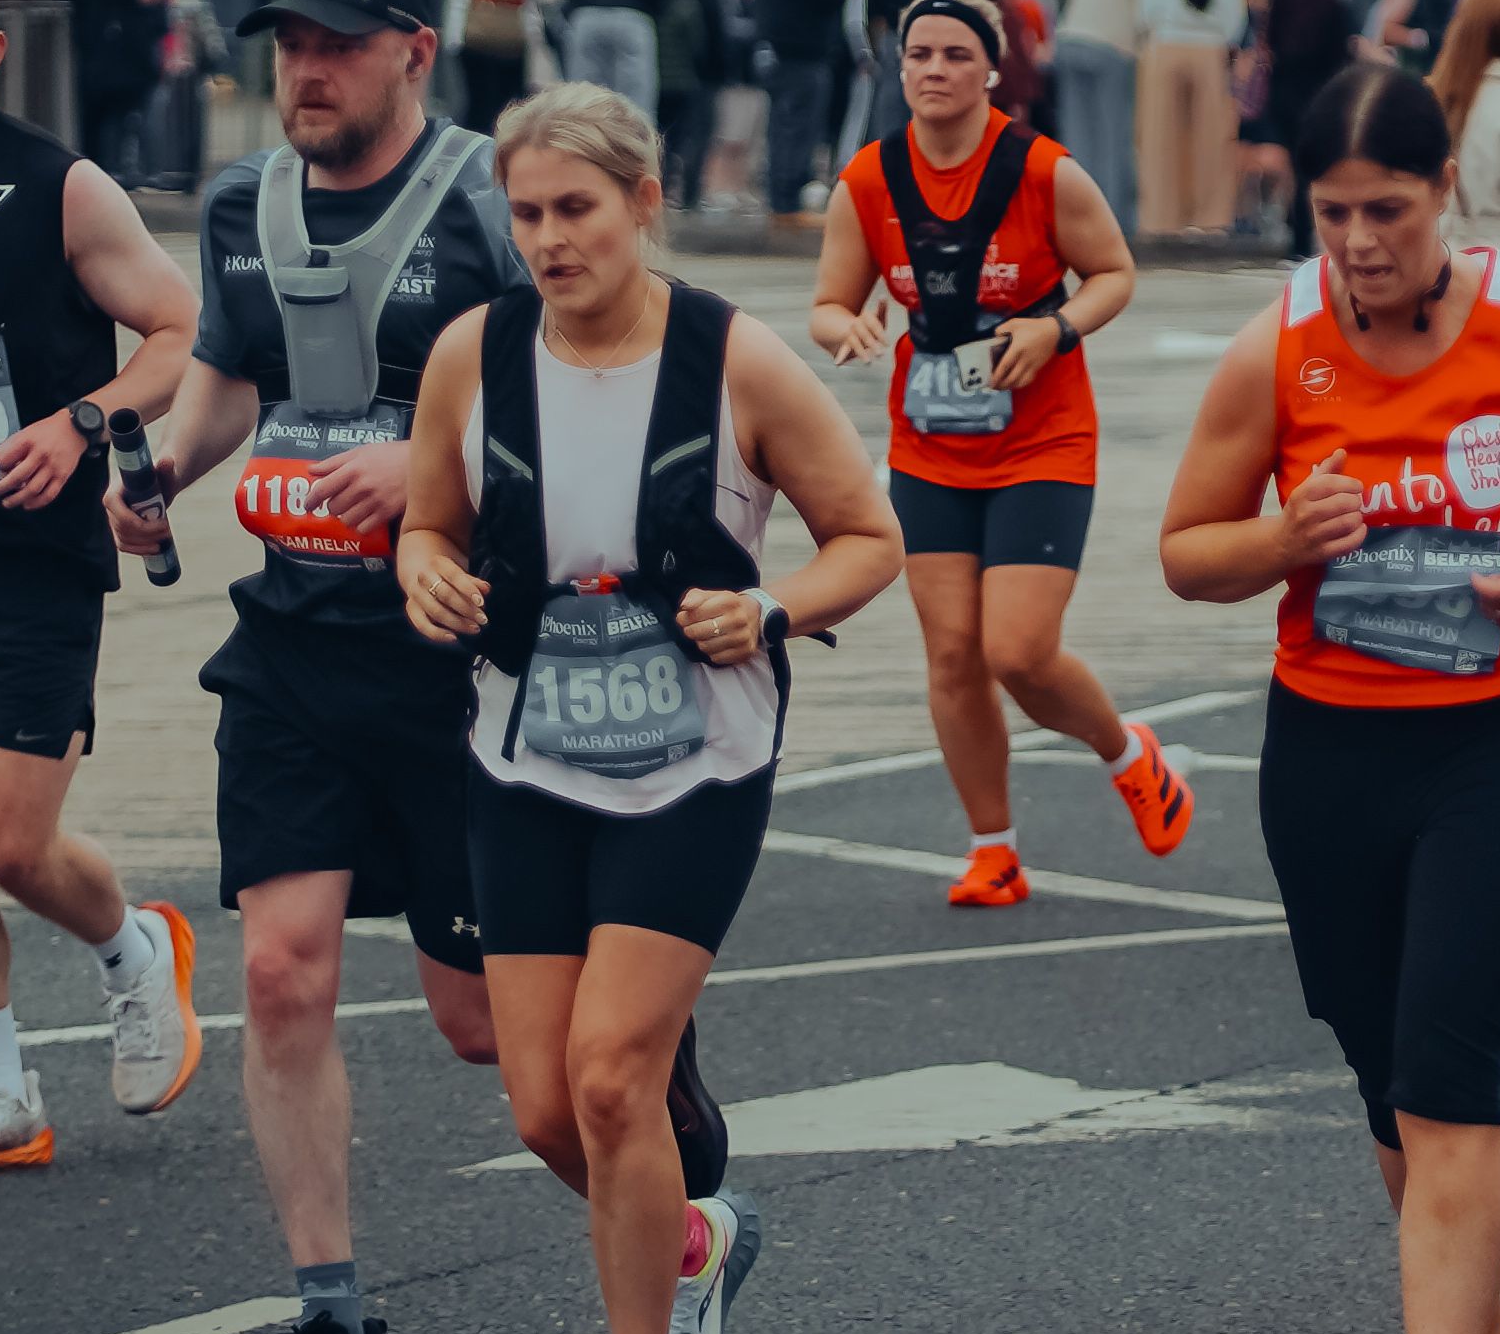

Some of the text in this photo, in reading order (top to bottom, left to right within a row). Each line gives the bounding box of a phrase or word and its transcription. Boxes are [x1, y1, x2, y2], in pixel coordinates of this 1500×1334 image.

[232, 255, 265, 271] KUK
[328, 427, 397, 444] BELFAST
[1399, 455, 1446, 514] to
[312, 536, 361, 553] RELAY
[1347, 544, 1415, 564] Phoenix
[545, 611, 660, 637] Phoenix BELFAS
[1354, 611, 1460, 644] MARATHON
[535, 655, 683, 724] 1568
[562, 728, 665, 750] MARATHON
